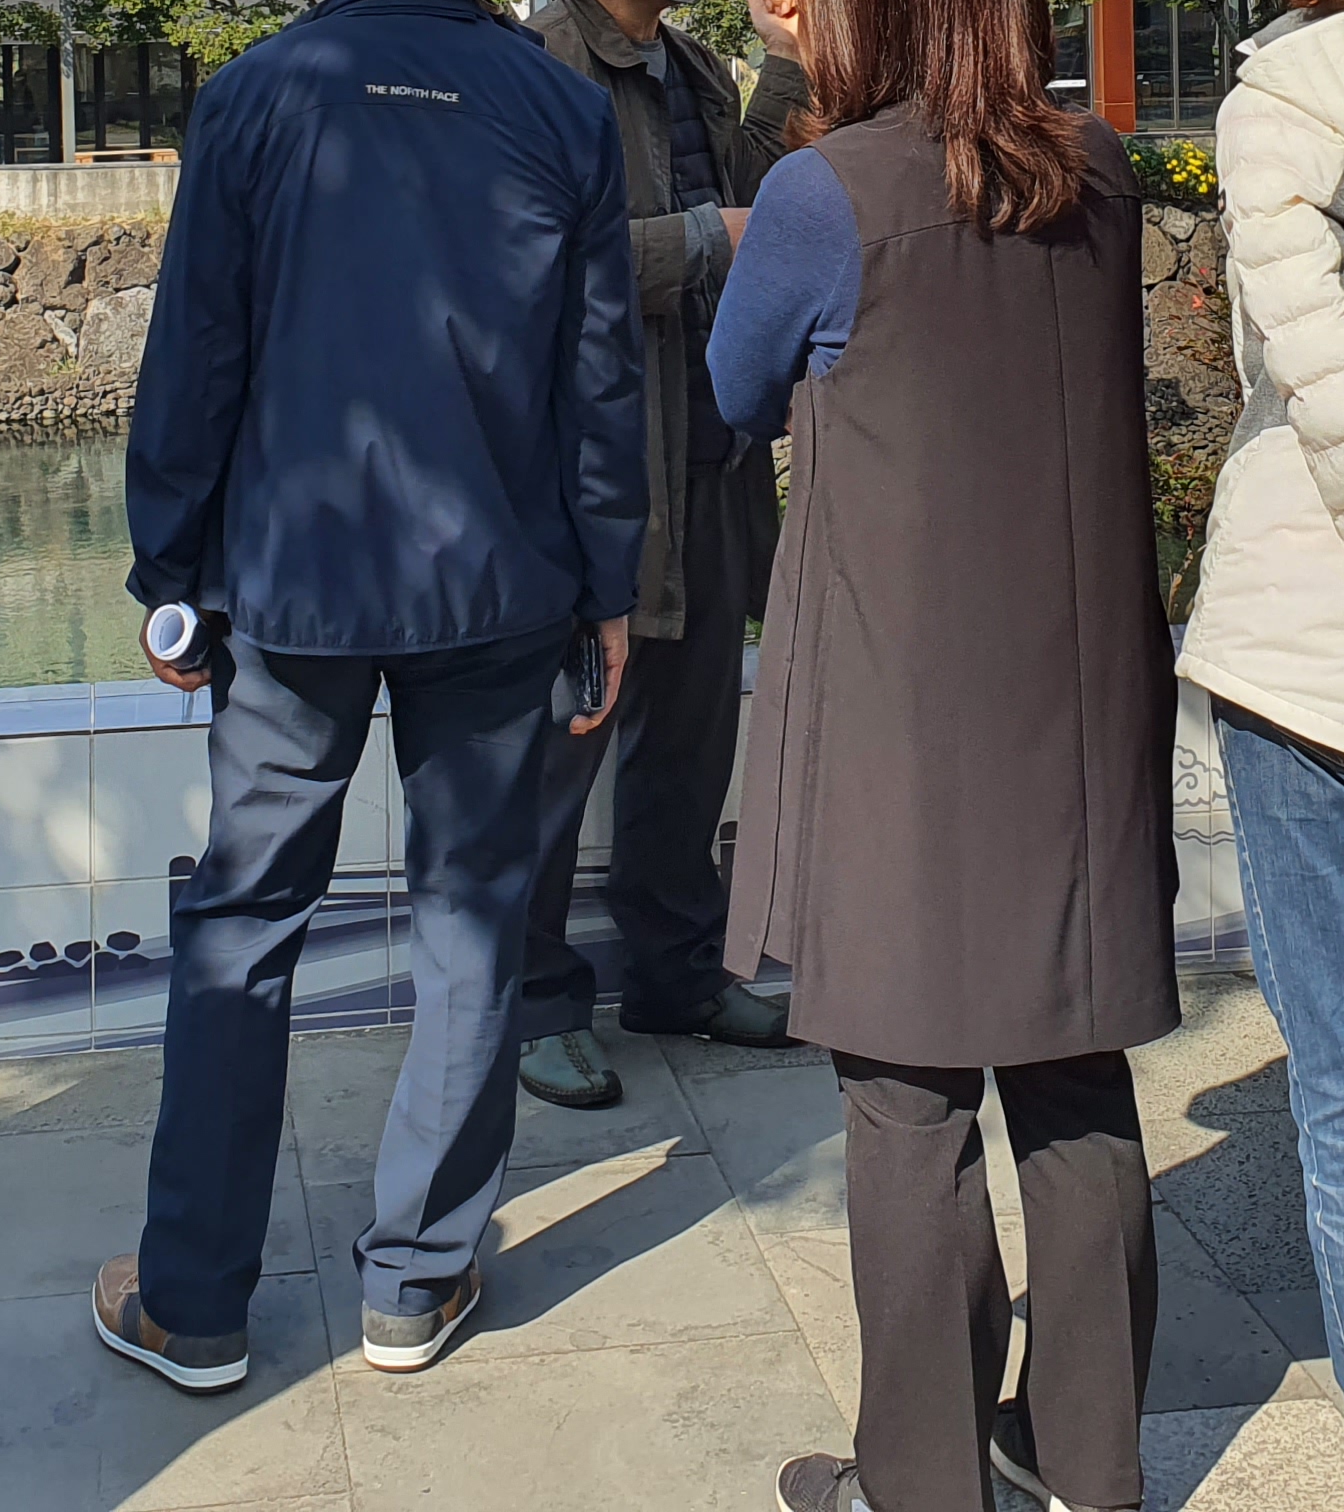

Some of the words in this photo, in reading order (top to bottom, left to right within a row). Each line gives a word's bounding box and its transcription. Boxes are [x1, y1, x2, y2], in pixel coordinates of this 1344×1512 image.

[365, 84, 388, 95] THE
[390, 85, 429, 99] NORTH
[431, 90, 460, 103] FACE
